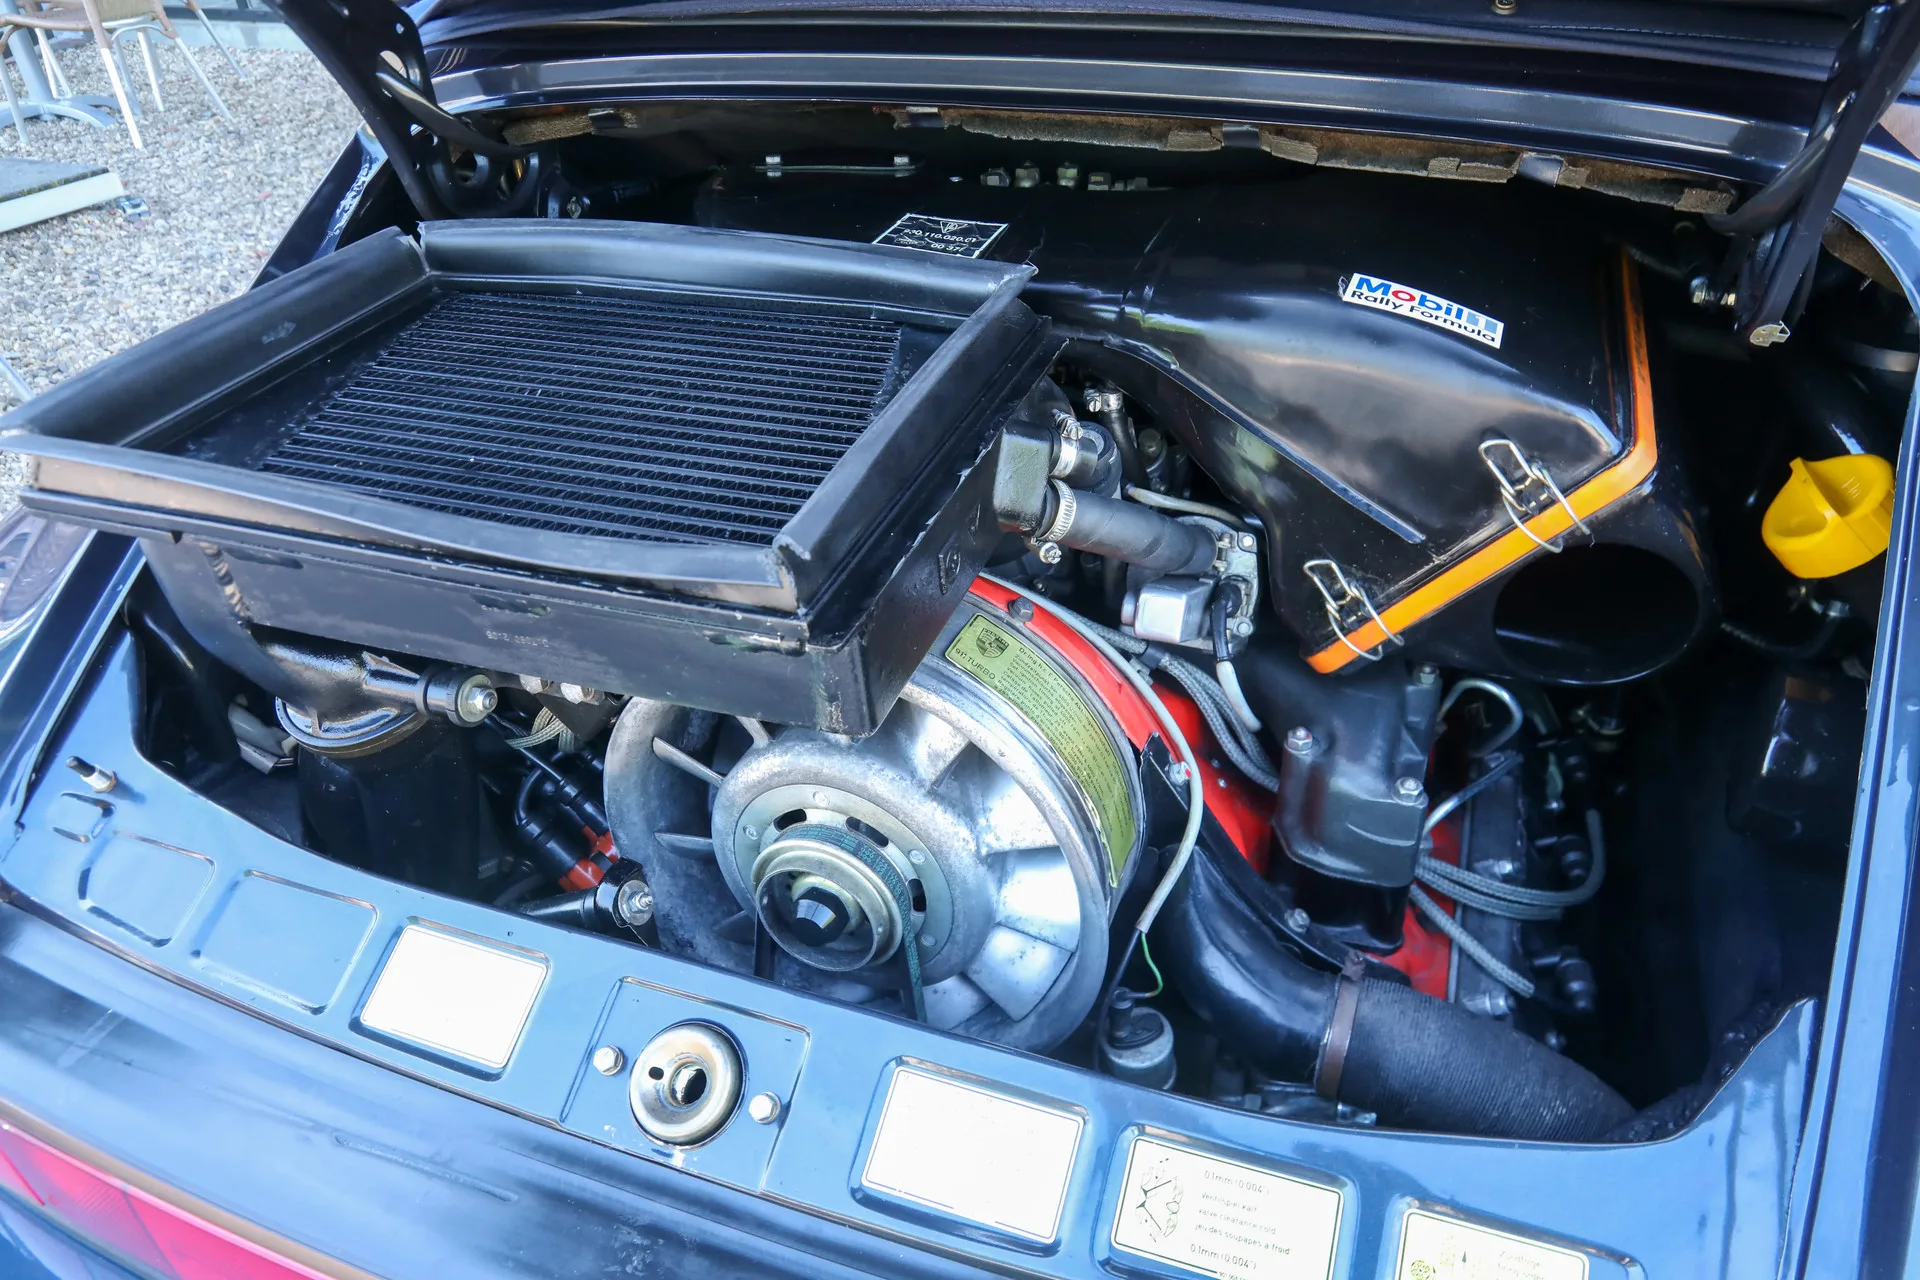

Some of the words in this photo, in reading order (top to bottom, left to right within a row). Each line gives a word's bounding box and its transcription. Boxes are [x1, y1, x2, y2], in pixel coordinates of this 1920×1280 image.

[1351, 290, 1404, 310] Rally
[1409, 305, 1496, 343] Formula
[1355, 276, 1464, 321] Mobil
[953, 648, 967, 659] 911
[966, 656, 997, 680] TURBO
[1271, 1243, 1290, 1255] froid
